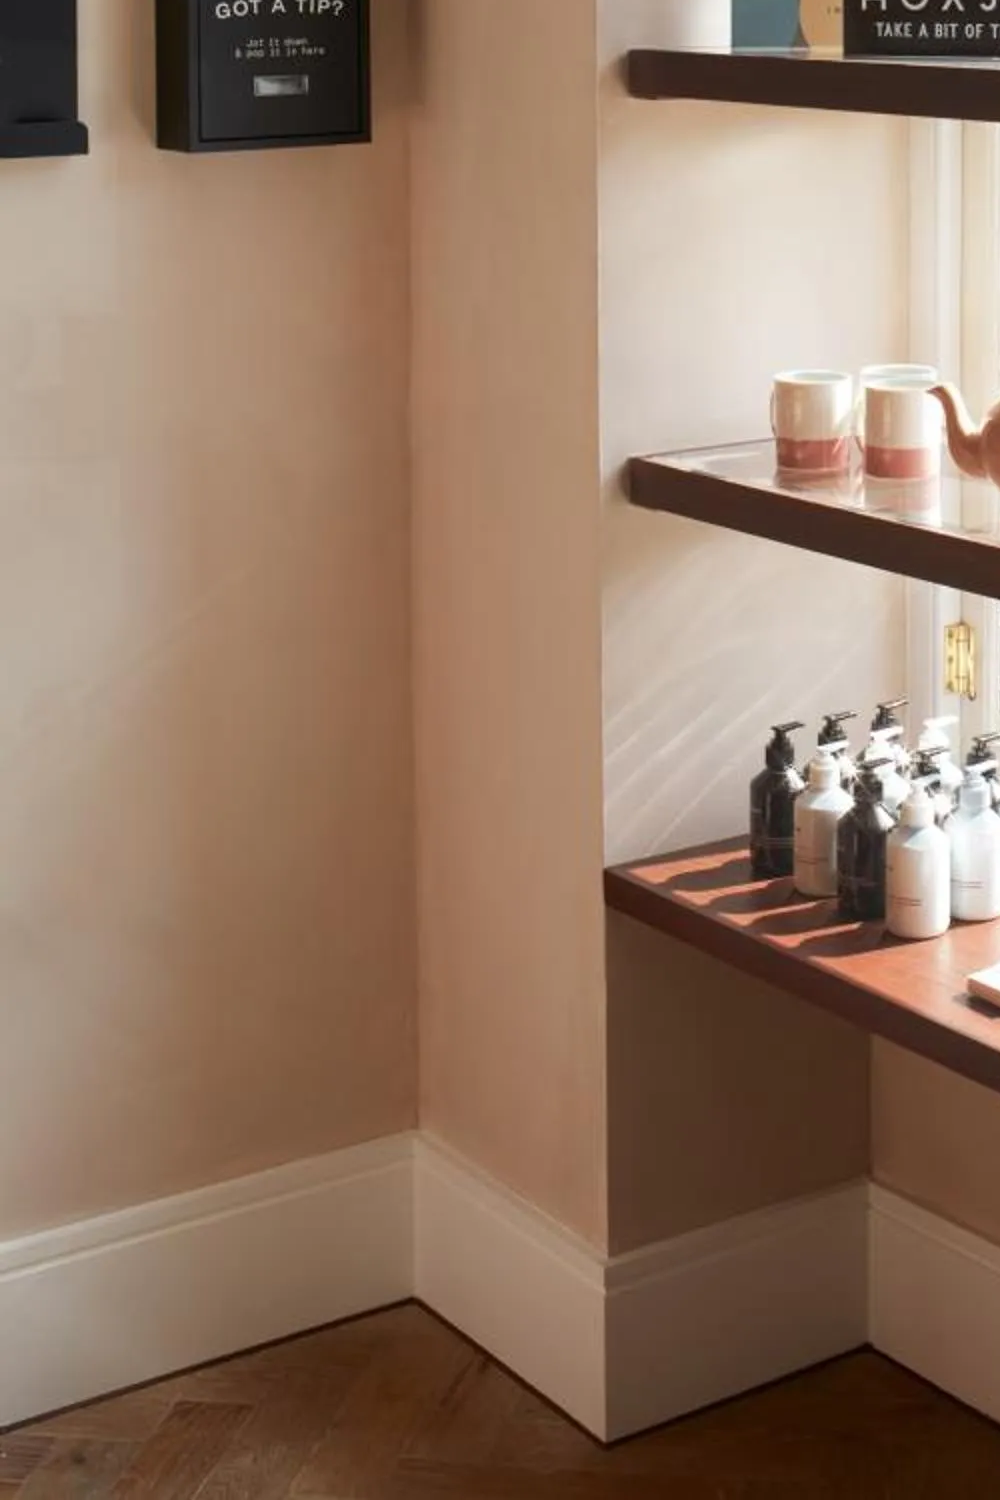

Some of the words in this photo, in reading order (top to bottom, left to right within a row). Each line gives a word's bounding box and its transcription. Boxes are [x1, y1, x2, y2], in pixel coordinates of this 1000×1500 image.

[876, 21, 913, 38] TAKE
[918, 23, 929, 38] A
[934, 23, 959, 38] BIT
[965, 23, 984, 39] OF
